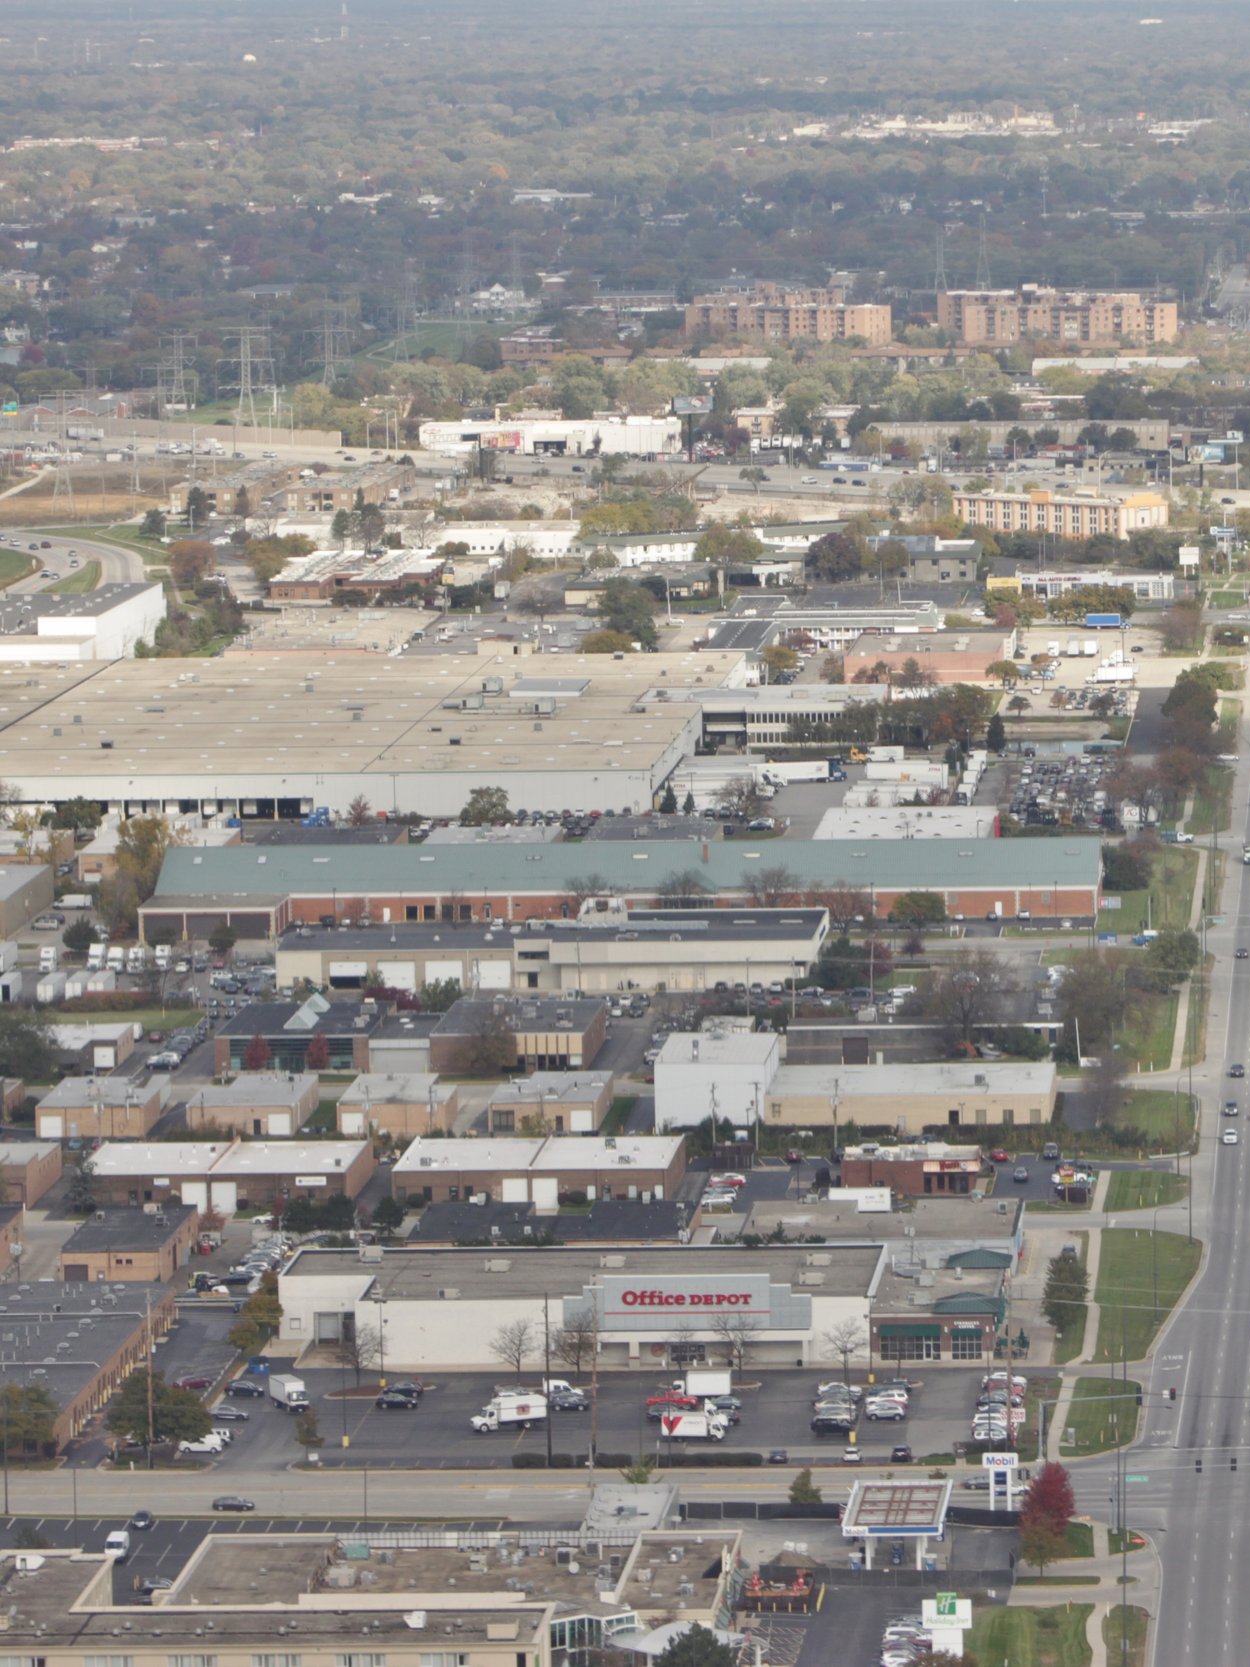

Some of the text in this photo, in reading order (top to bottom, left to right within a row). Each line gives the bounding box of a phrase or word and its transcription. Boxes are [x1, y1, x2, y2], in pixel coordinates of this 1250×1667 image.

[621, 1290, 752, 1306] Office DEPOT
[986, 1456, 1015, 1466] Mobil
[926, 1617, 954, 1626] Holiday
